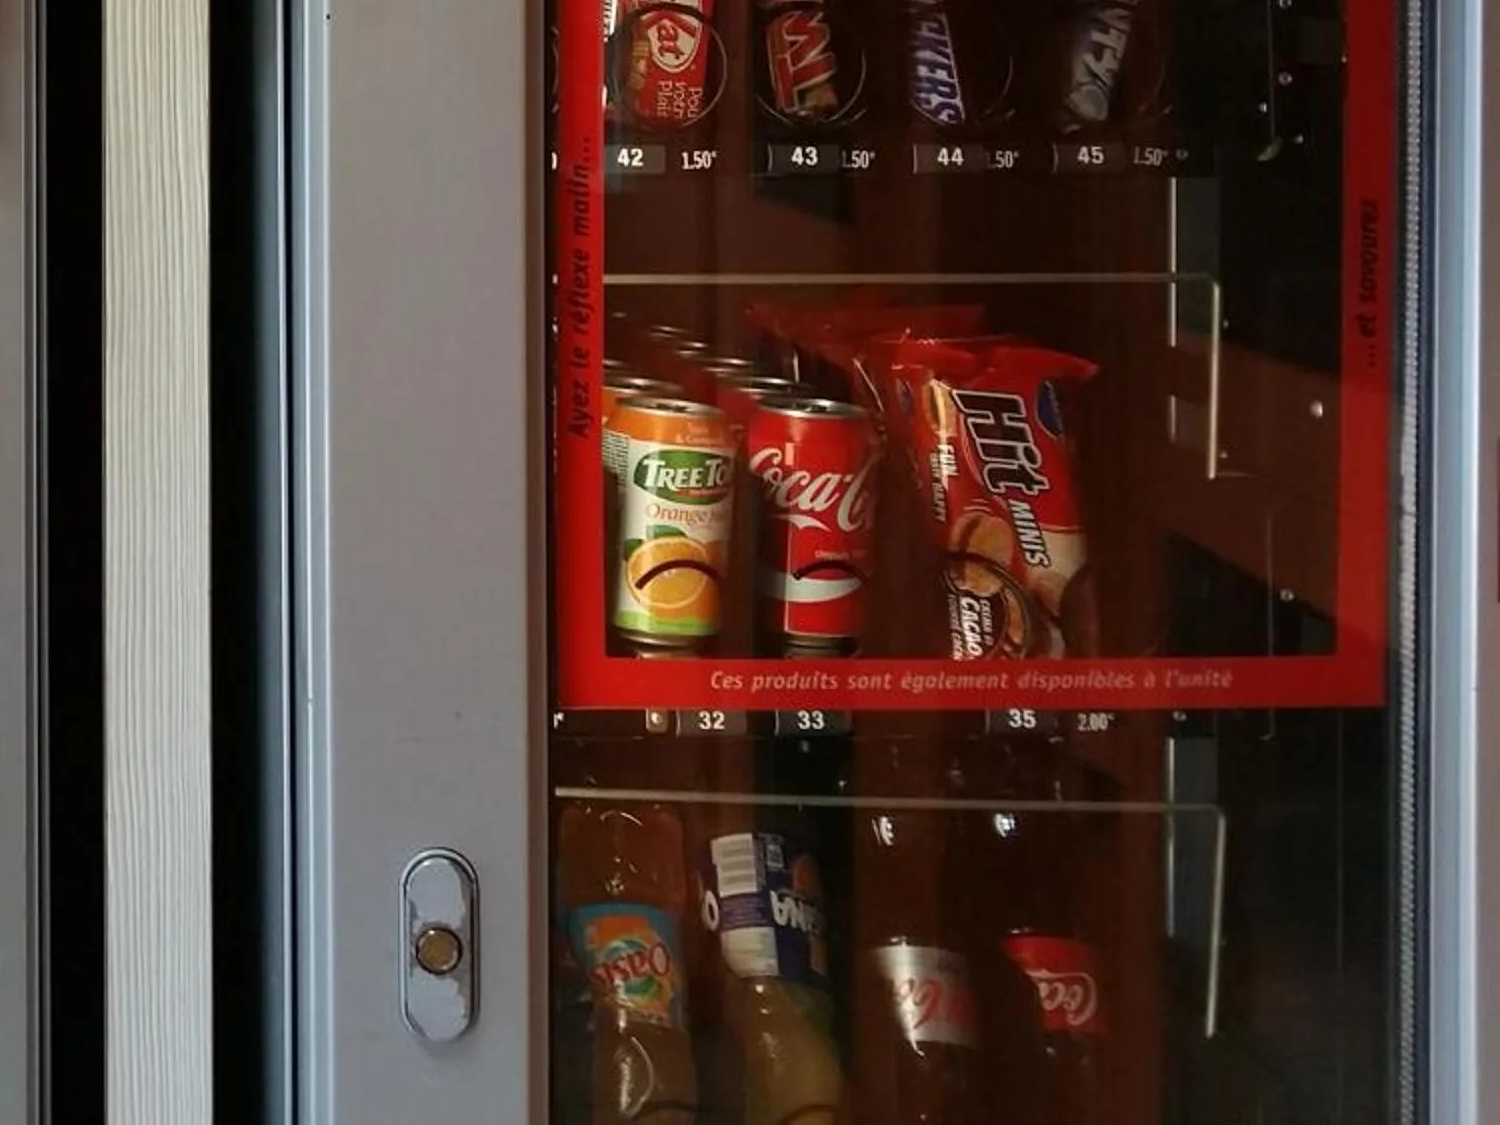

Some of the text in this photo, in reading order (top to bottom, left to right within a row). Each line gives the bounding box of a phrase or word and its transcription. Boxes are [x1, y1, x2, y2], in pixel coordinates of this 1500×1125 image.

[617, 147, 645, 167] 42
[791, 146, 818, 166] 43
[937, 147, 964, 166] 44
[1077, 146, 1105, 164] 45
[568, 248, 594, 331] réflexe
[569, 345, 590, 369] le
[1008, 499, 1050, 569] MINIS
[960, 595, 984, 657] CACAO
[710, 671, 743, 689] Ces
[751, 670, 838, 692] produits
[848, 671, 891, 689] sont
[901, 671, 1009, 693] également
[1017, 670, 1135, 692] disponibles
[1164, 670, 1233, 689] l'unité
[699, 711, 725, 730] 32
[798, 711, 824, 730] 33
[1009, 709, 1036, 729] 35
